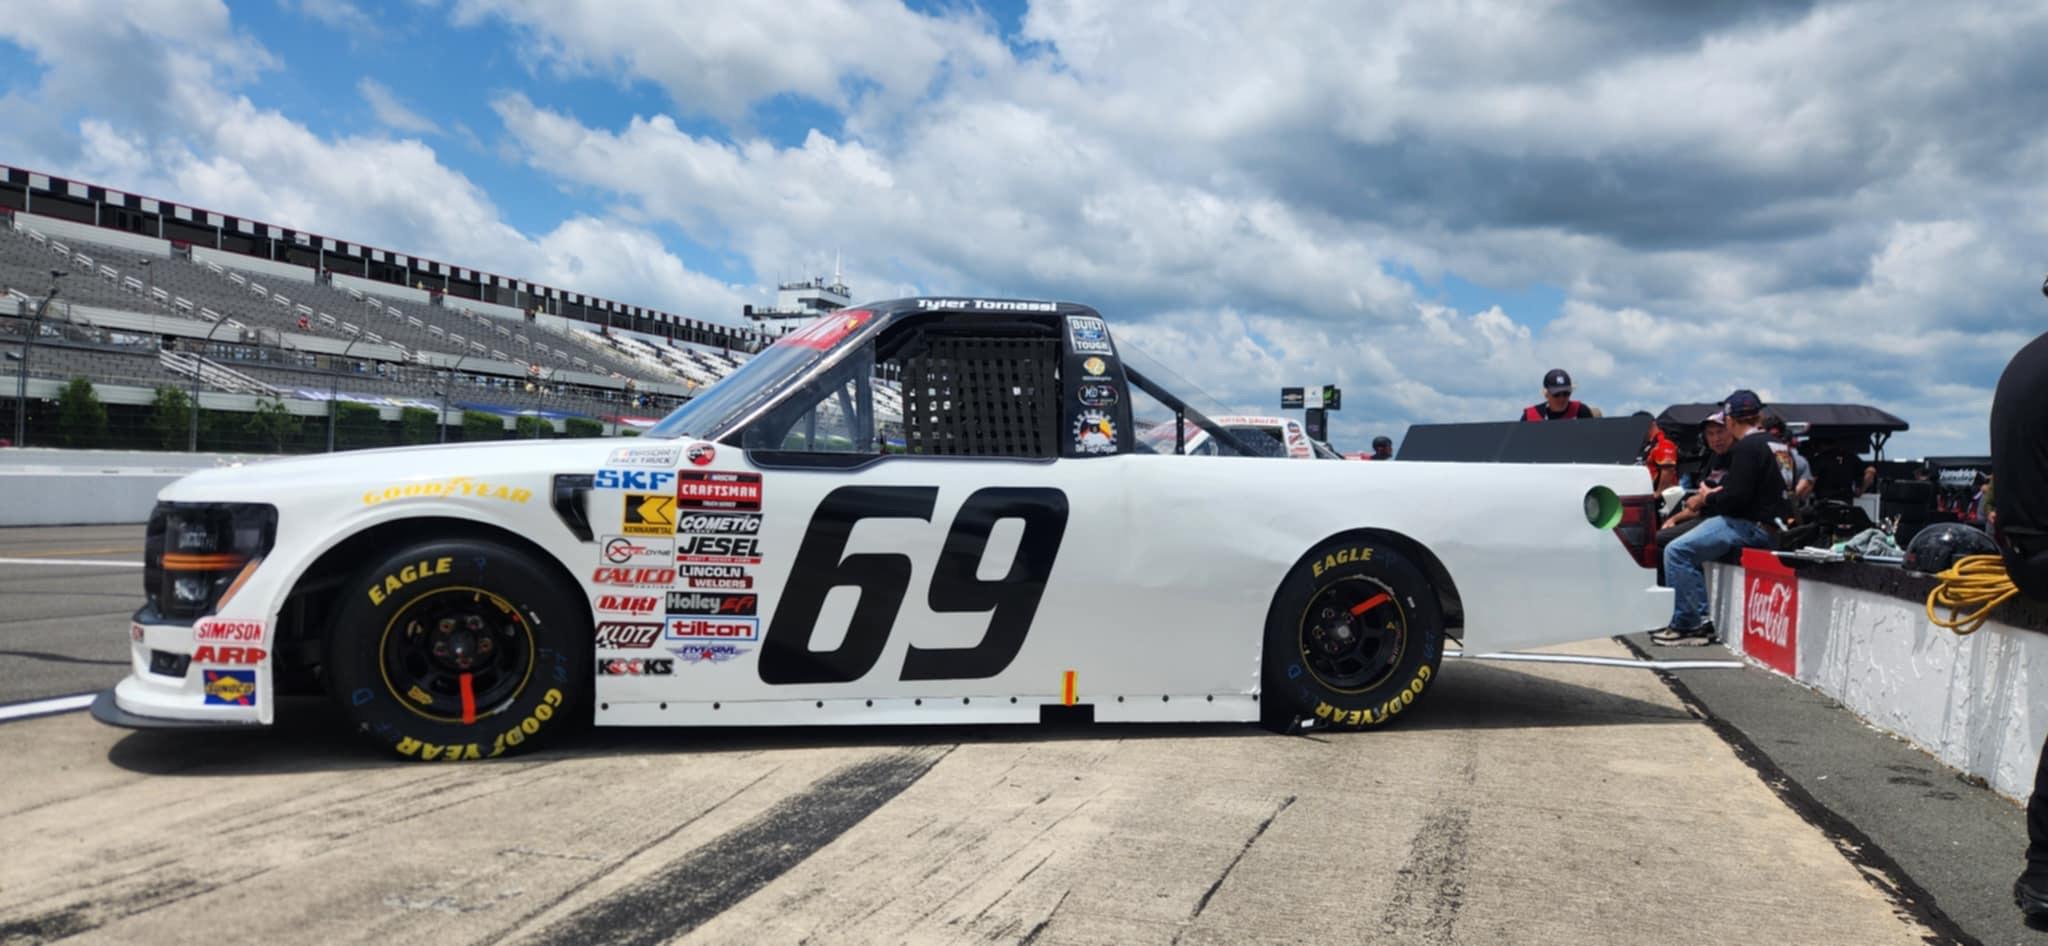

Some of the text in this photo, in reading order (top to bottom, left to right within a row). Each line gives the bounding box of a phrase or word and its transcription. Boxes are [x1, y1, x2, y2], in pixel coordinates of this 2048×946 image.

[918, 299, 1058, 312] Tyler Tomassi
[1072, 319, 1102, 330] BUILT
[1076, 341, 1108, 350] TOUGH
[595, 469, 675, 490] SKF
[682, 484, 757, 498] CRAFTSMAN
[680, 515, 760, 531] COMETIC
[678, 536, 763, 557] JESEL
[1311, 547, 1374, 577] EAGLE
[592, 567, 676, 584] CALICO
[681, 566, 742, 577] LINCOLN
[367, 557, 453, 606] EAGLE
[694, 577, 747, 588] WELDERS
[757, 485, 1069, 685] 69
[667, 592, 721, 614] Holley
[197, 622, 263, 640] SIMPSON
[595, 624, 659, 644] KLOTZ
[672, 620, 752, 637] tilton
[191, 645, 267, 664] ARP
[597, 657, 673, 676] KOOKS
[206, 683, 255, 694] SUNOCO
